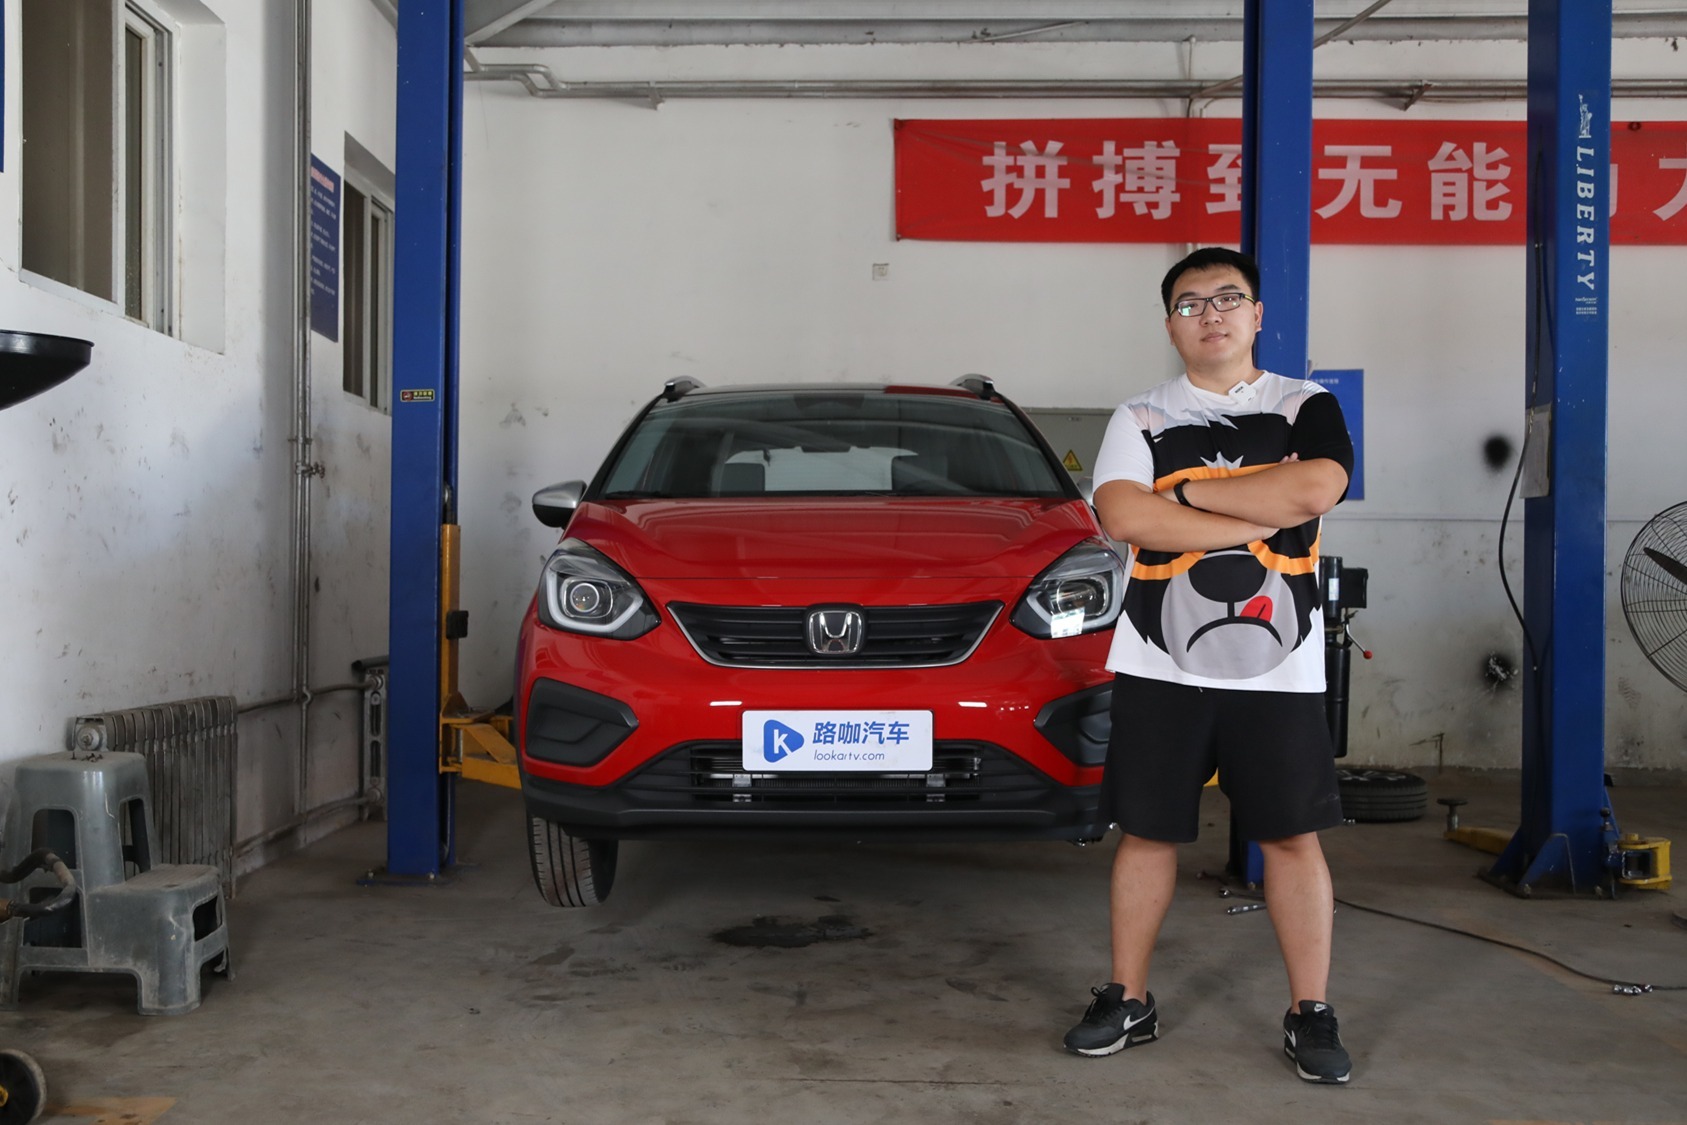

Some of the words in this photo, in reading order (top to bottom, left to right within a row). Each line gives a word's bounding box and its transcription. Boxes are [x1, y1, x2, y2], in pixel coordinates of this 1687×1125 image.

[1576, 145, 1595, 291] LIBERTY
[812, 721, 910, 745] 路咖汽车
[813, 749, 885, 761] lookartv.com
